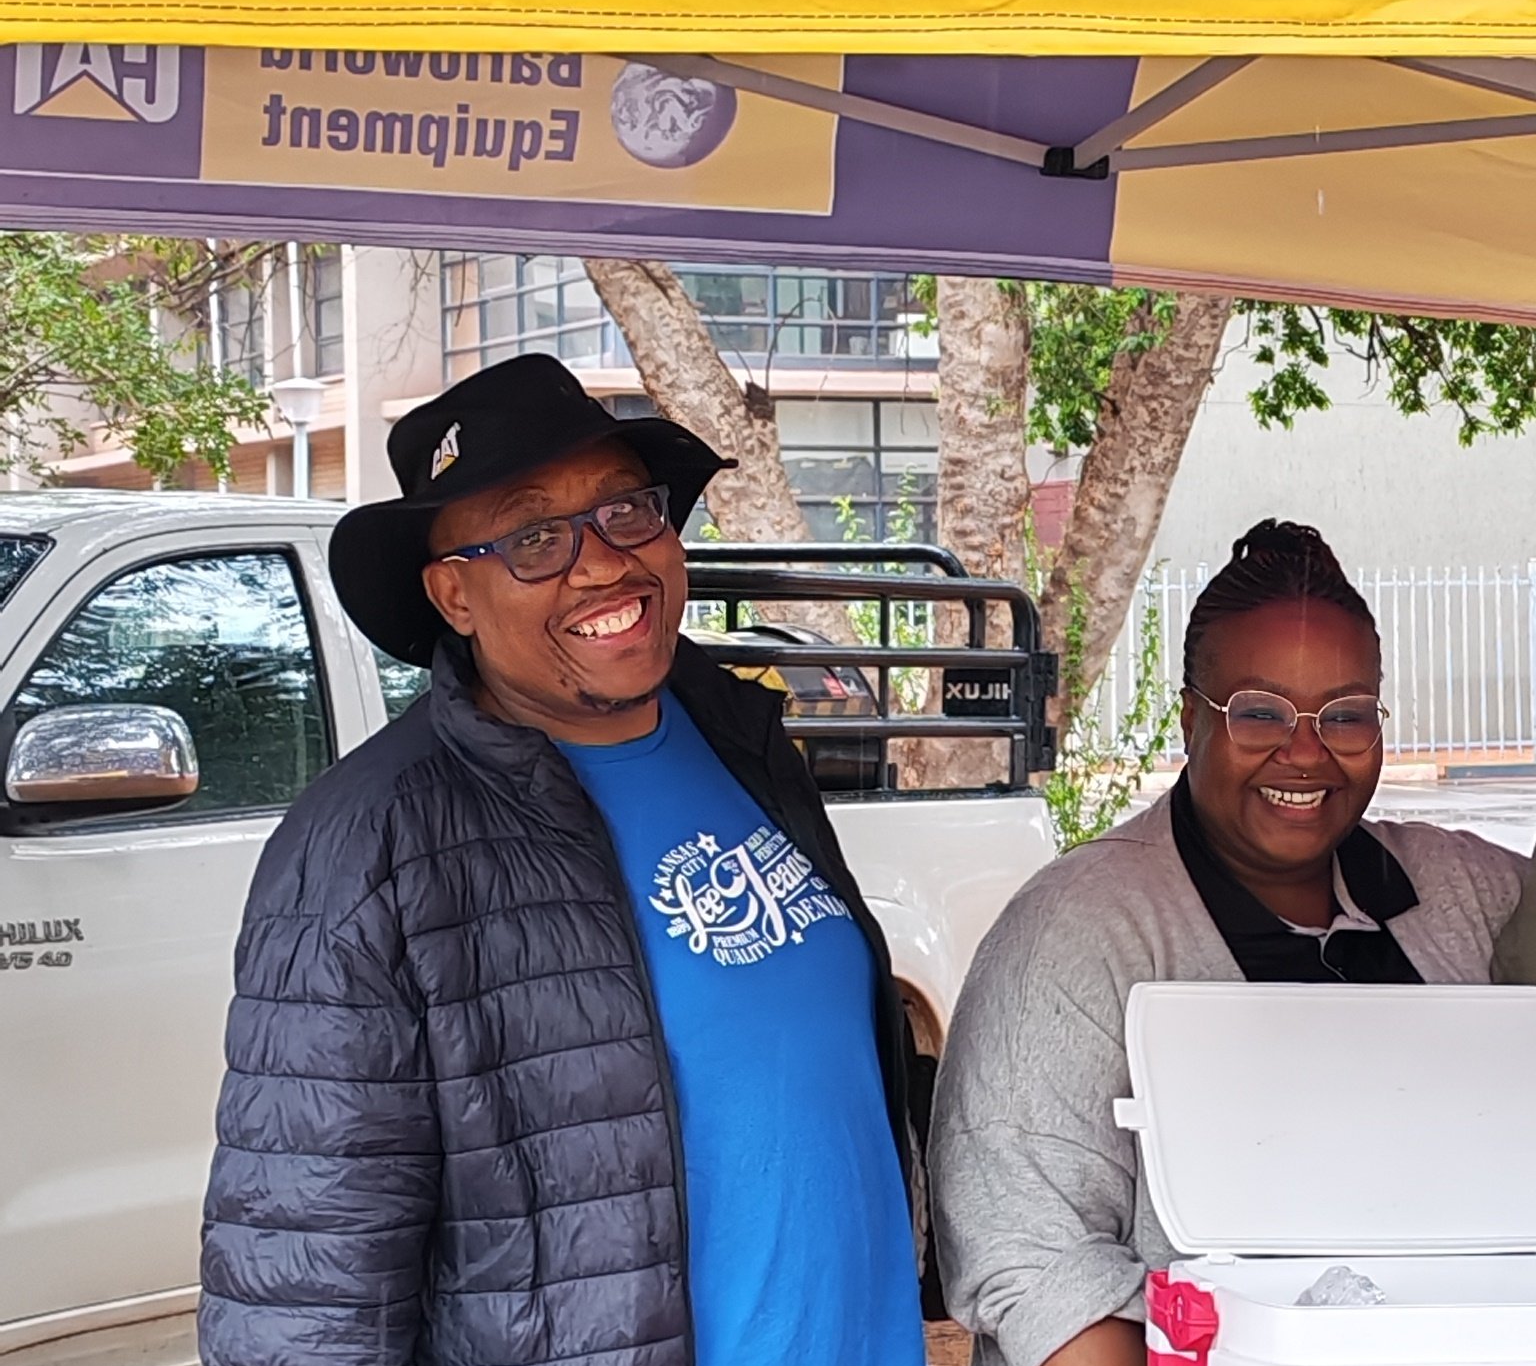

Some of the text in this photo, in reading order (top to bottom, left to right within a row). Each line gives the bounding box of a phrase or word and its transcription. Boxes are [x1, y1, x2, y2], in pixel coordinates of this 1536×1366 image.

[431, 423, 460, 480] CAT
[653, 841, 699, 887] KANSAS
[681, 855, 708, 876] CITY
[0, 918, 84, 948] HILUX
[712, 927, 760, 948] PREMIUM
[712, 937, 773, 967] QUALITY
